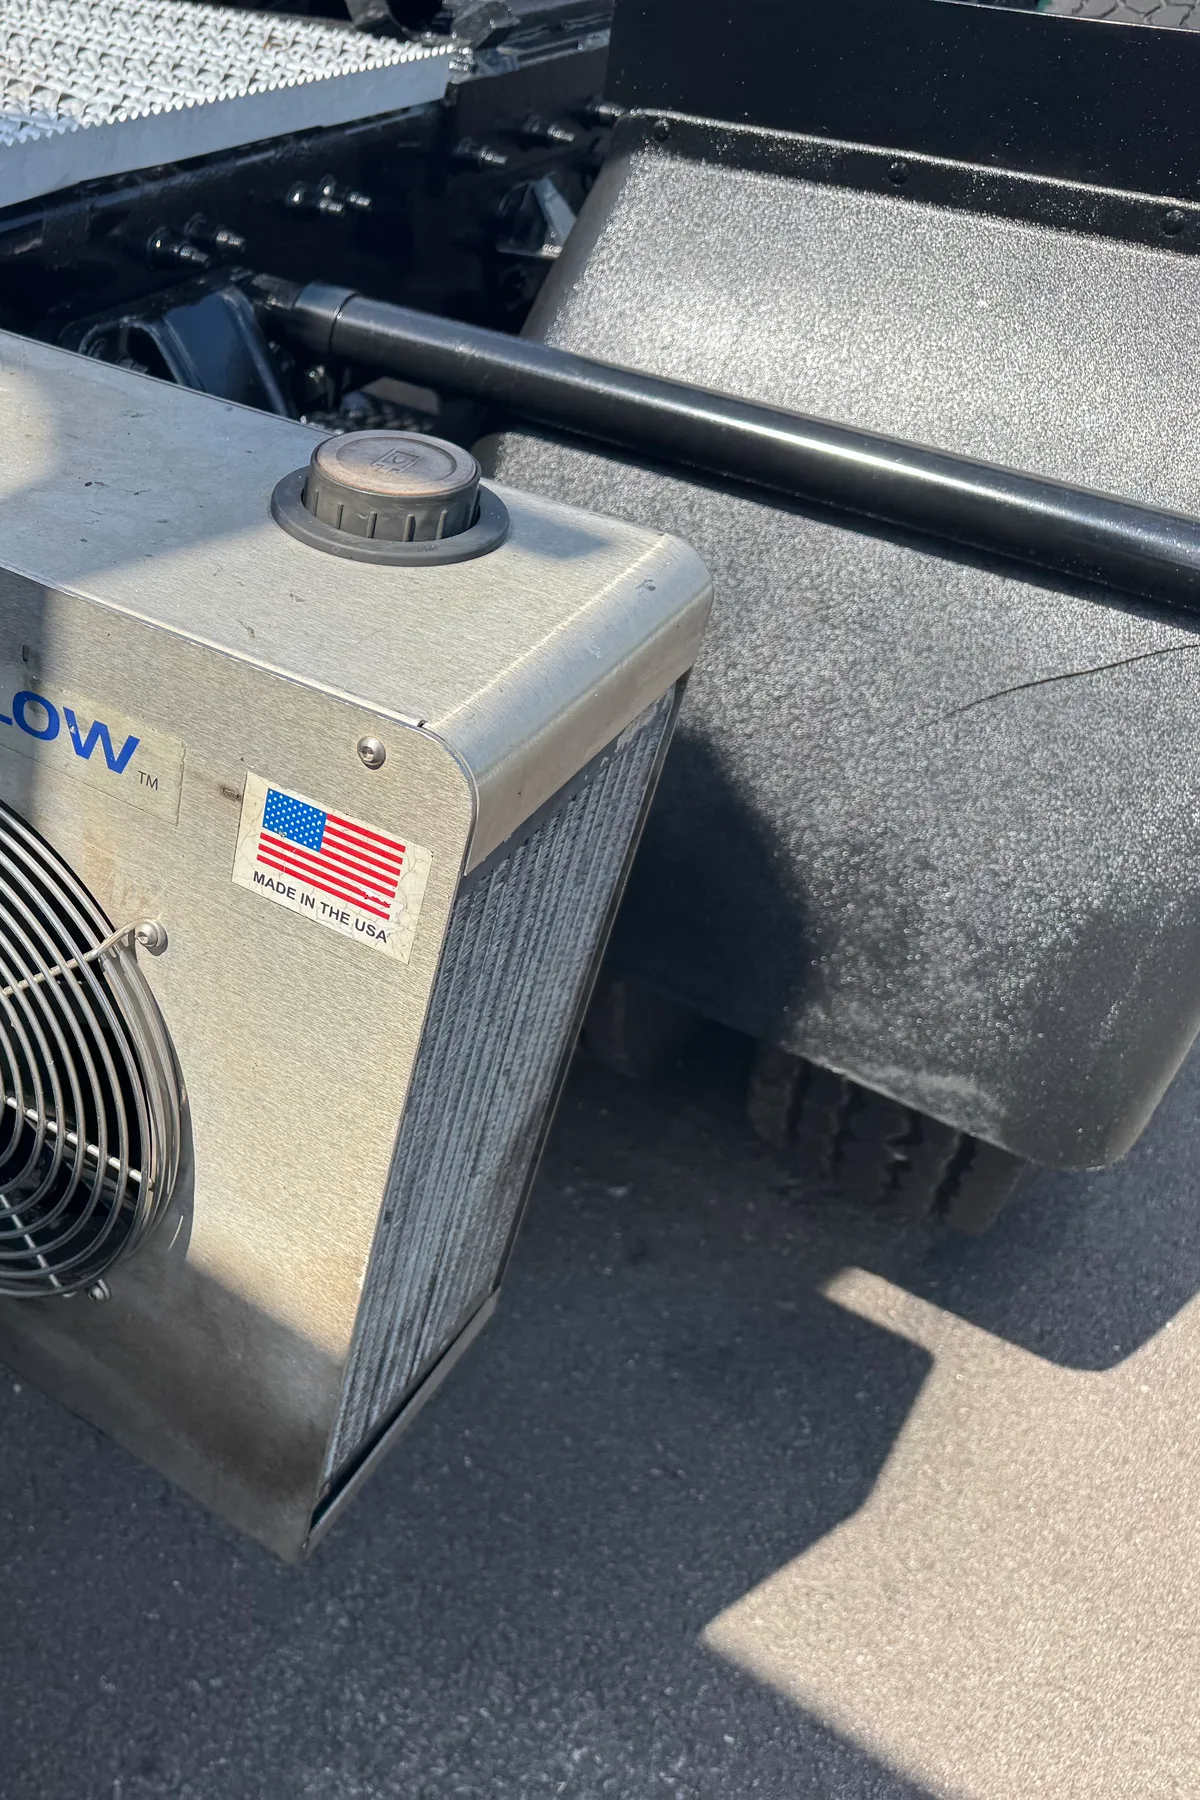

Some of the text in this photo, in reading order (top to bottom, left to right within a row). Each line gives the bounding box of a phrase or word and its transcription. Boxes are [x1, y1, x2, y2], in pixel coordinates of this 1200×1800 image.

[253, 870, 388, 943] MADE IN THE USA
